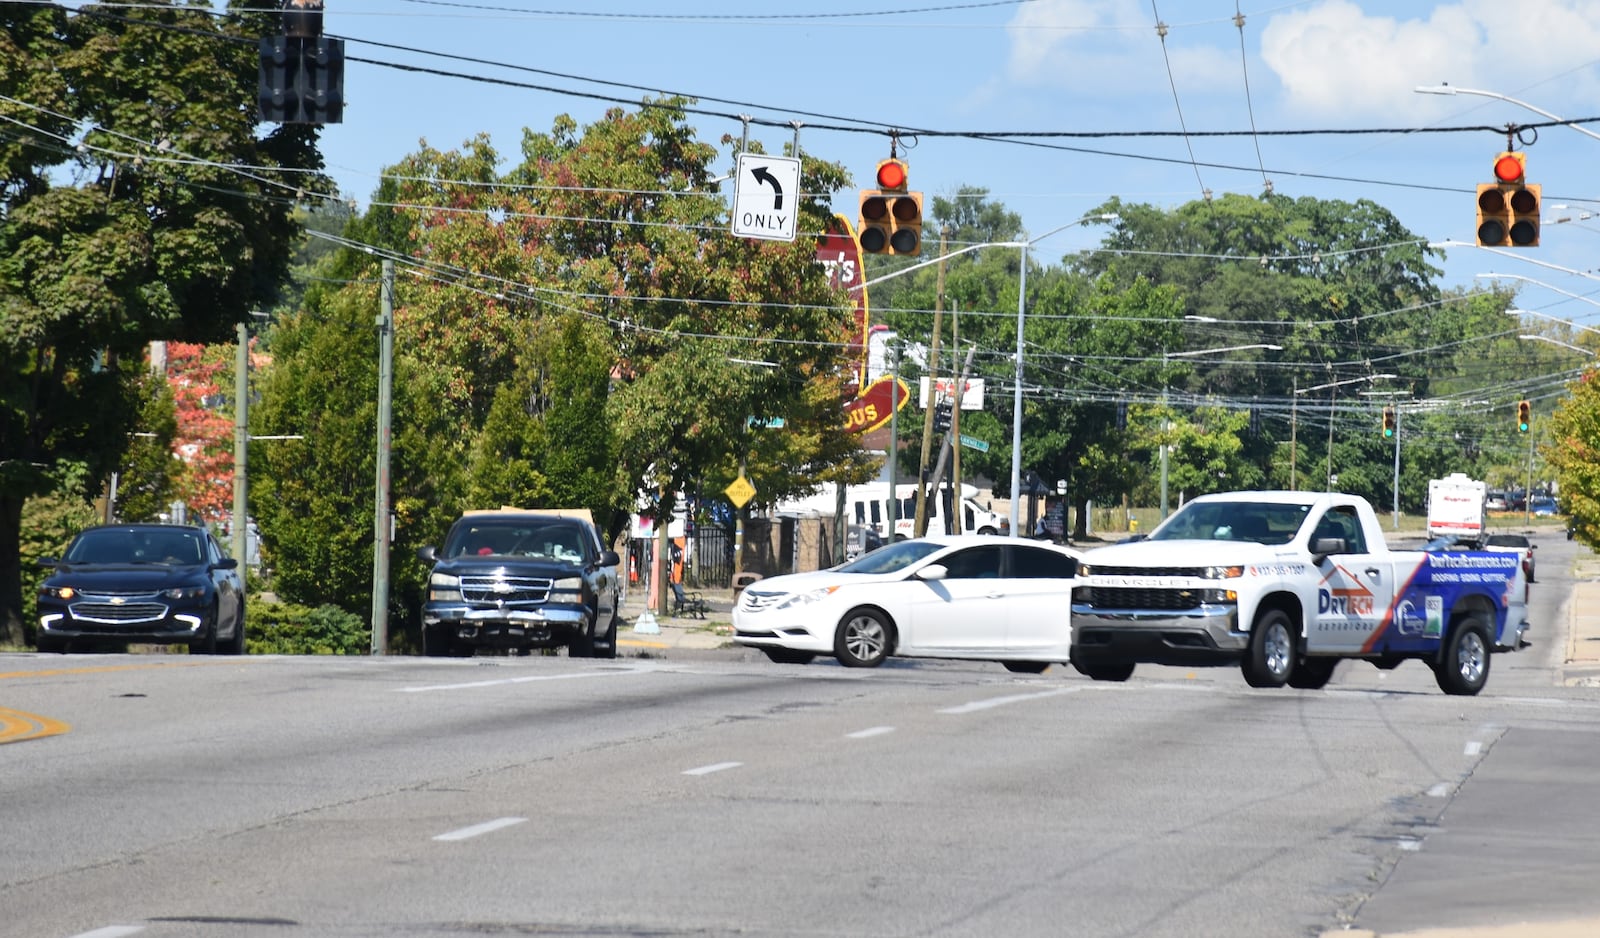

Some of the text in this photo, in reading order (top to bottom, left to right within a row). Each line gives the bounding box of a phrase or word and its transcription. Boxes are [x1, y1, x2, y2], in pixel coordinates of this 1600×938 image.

[743, 212, 787, 230] ONLY
[843, 403, 878, 429] OUS
[729, 490, 751, 498] OUTLET
[1091, 578, 1192, 587] CHEVROLET
